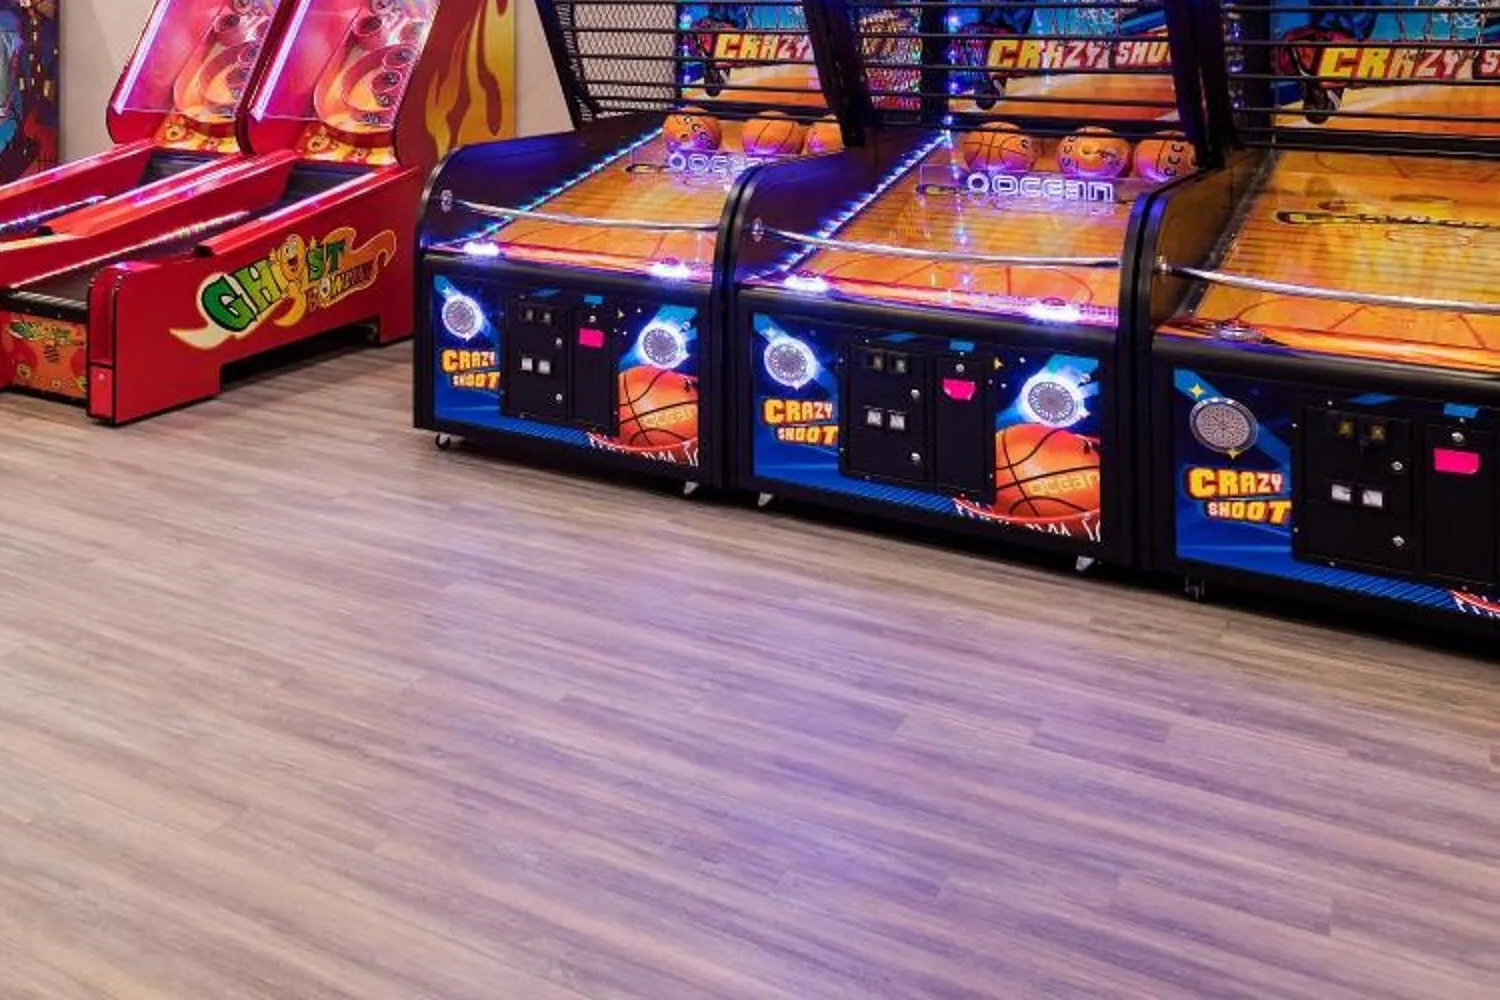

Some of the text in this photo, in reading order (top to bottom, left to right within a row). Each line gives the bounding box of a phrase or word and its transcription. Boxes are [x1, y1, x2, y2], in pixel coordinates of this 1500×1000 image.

[986, 40, 1173, 69] CRAZY SHO
[1318, 47, 1470, 79] CRAZY
[201, 233, 349, 332] GHOST
[441, 348, 496, 372] CRAZY
[452, 371, 501, 390] SHOOT
[763, 398, 833, 425] CRAZY
[777, 425, 839, 445] SHOOT
[1188, 467, 1284, 499] CRAZY
[1207, 500, 1293, 525] SHOOT
